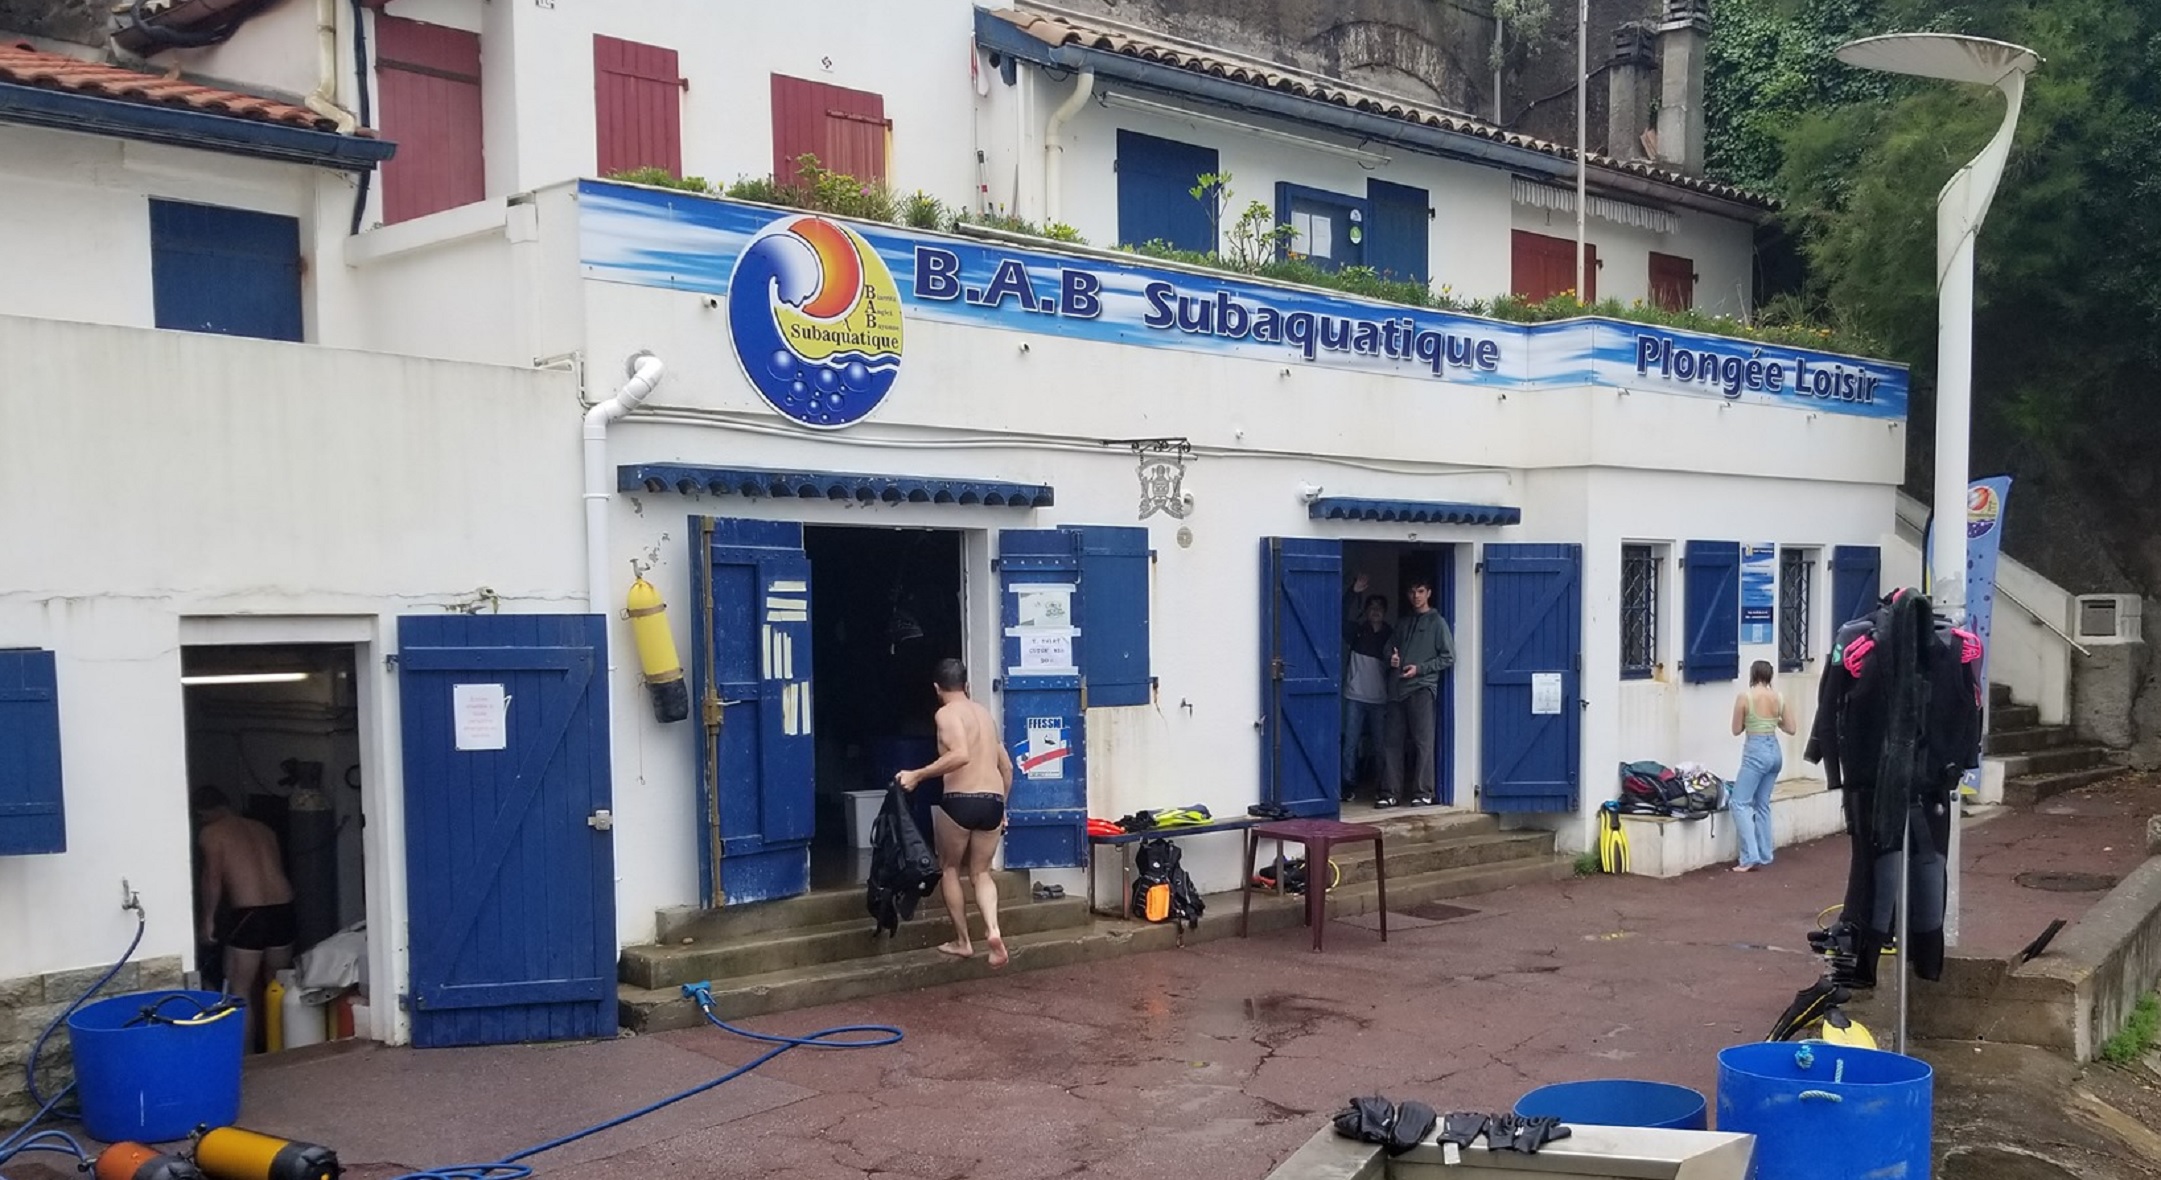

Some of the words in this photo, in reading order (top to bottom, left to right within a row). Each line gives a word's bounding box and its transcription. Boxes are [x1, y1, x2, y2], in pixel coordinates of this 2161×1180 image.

[791, 323, 899, 350] Subaquatique
[914, 245, 1101, 318] B.A.B
[1143, 281, 1500, 376] Subaquatique
[1637, 334, 1785, 398] Plongée
[1795, 357, 1878, 403] Loisir
